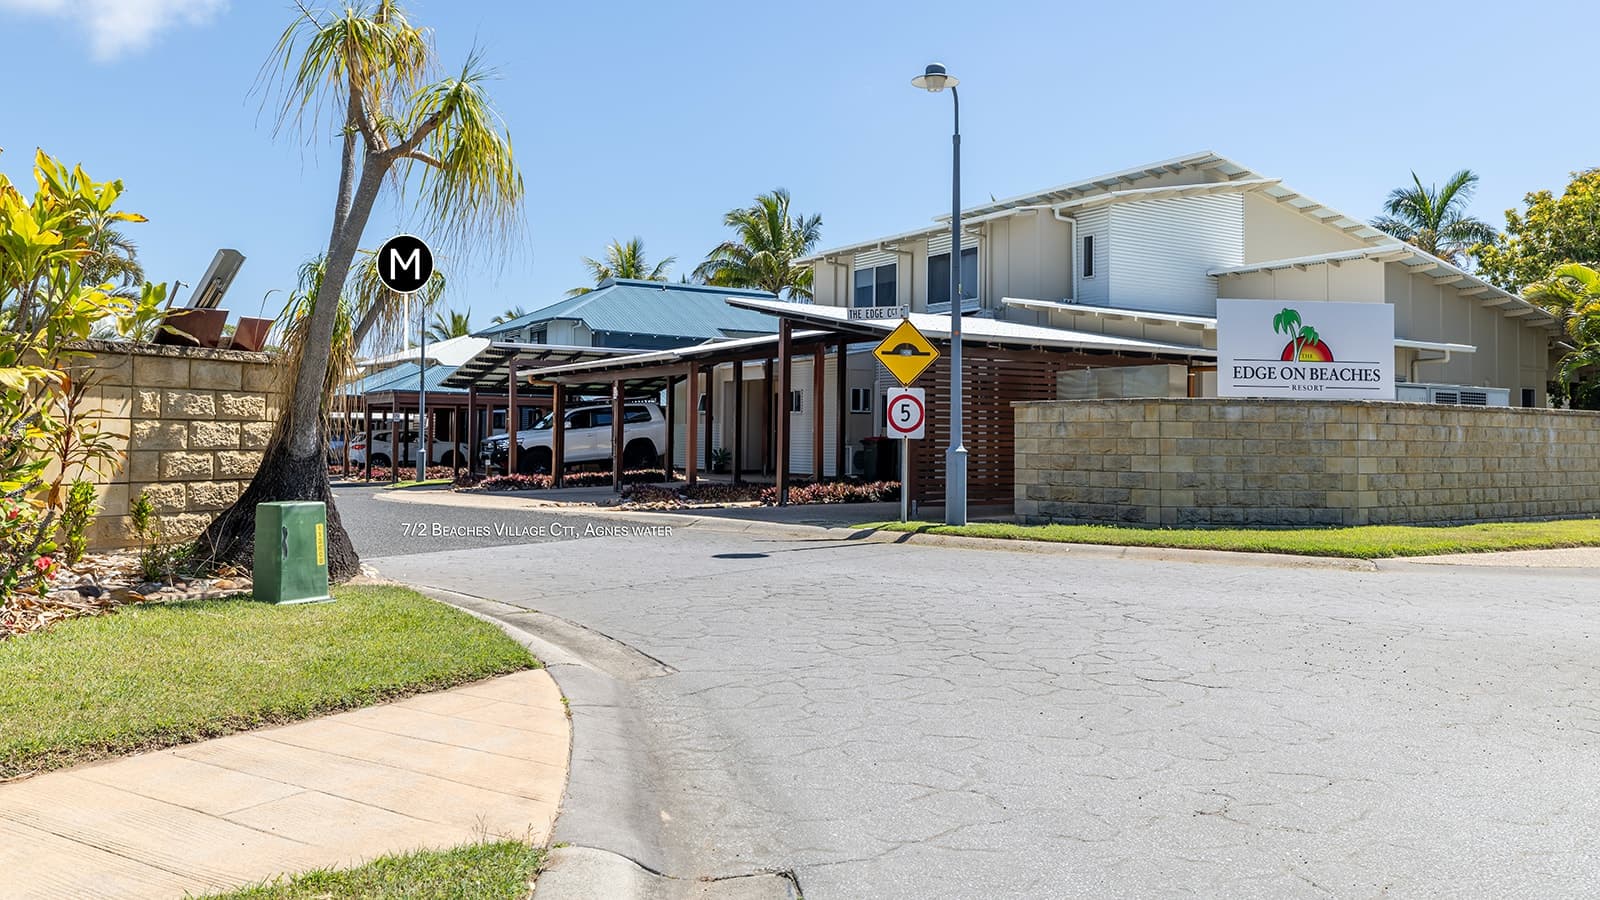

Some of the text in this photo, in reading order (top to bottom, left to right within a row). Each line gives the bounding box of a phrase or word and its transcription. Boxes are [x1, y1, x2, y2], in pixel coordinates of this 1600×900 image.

[849, 309, 862, 319] THE
[865, 308, 884, 319] EDGE
[1233, 365, 1381, 382] EDGE ON BEACHES
[1291, 384, 1324, 392] RESORT
[900, 403, 911, 422] 5
